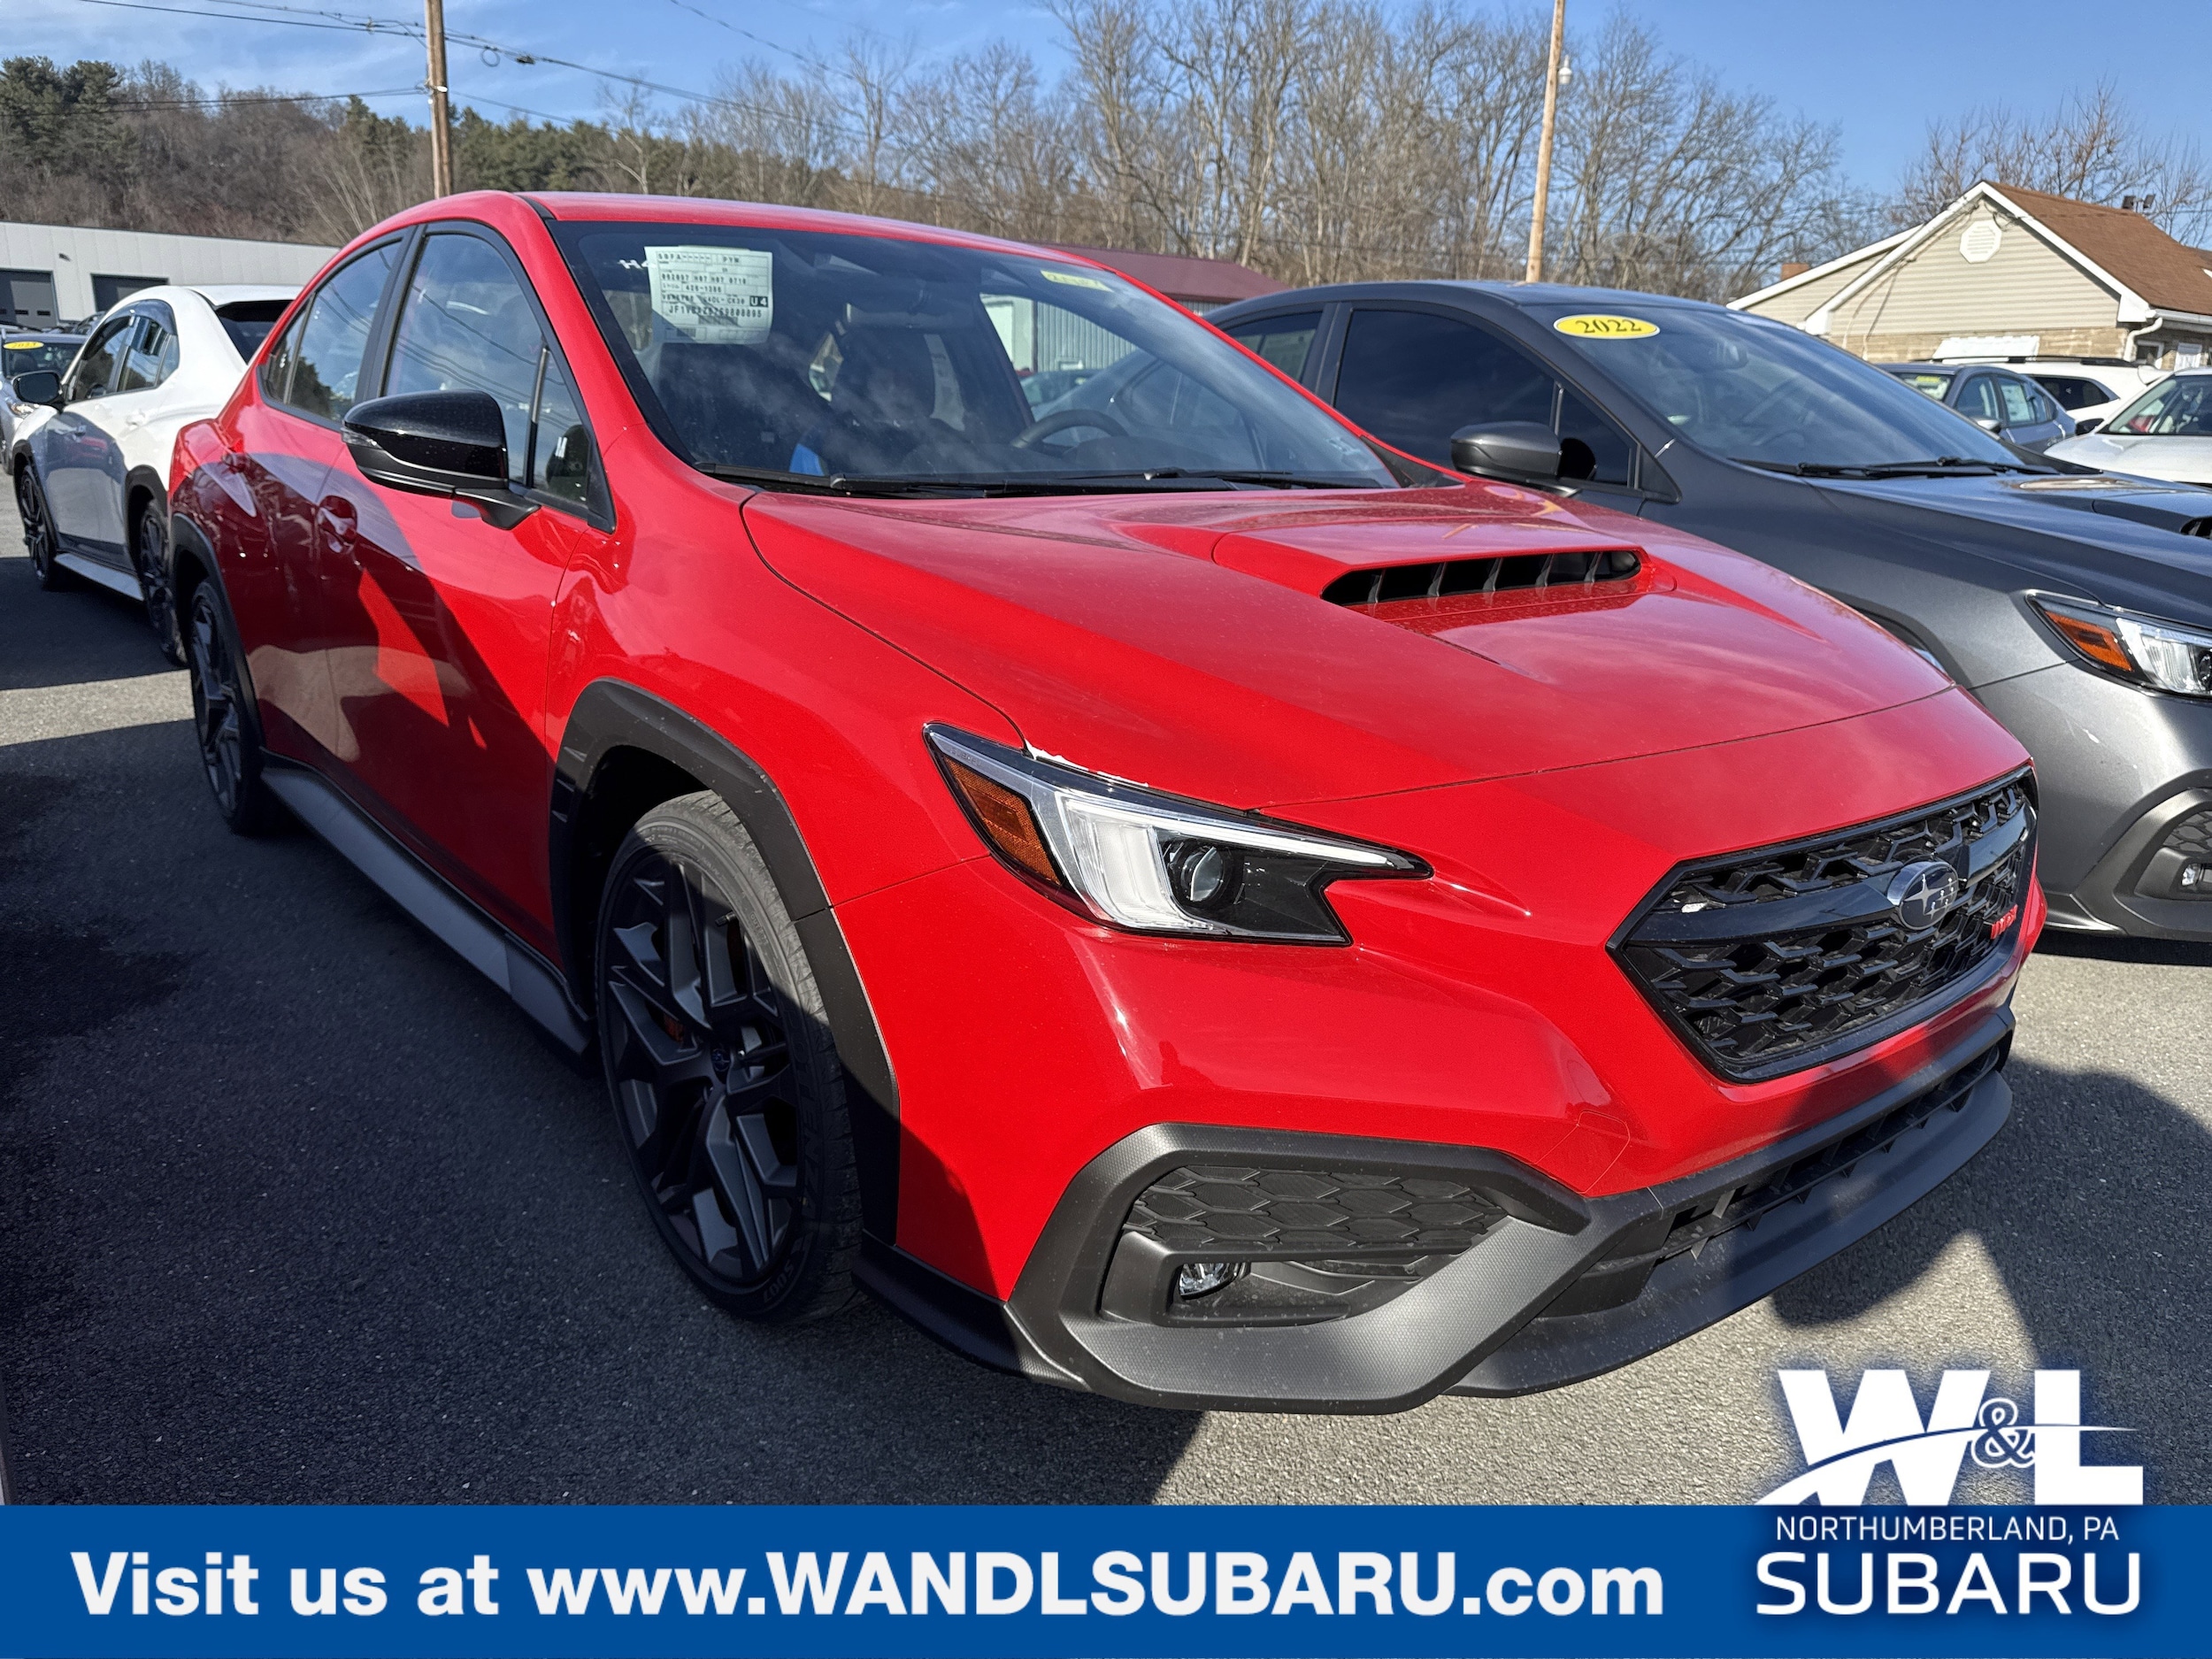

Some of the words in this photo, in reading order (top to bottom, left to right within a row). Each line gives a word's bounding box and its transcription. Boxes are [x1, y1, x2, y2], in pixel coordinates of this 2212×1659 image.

[749, 296, 767, 307] U4
[1575, 319, 1642, 334] 2022
[763, 1258, 795, 1304] S007
